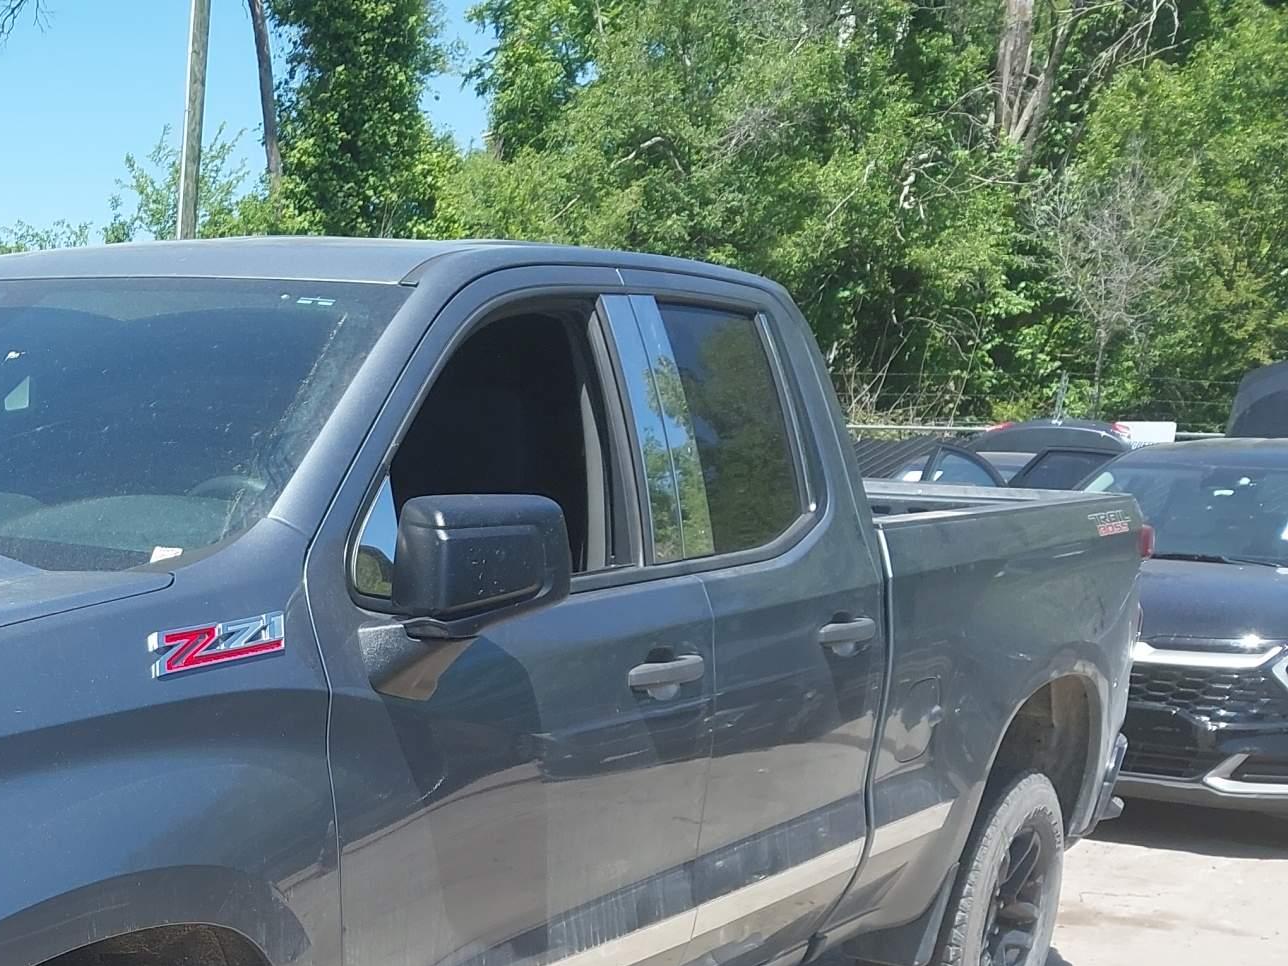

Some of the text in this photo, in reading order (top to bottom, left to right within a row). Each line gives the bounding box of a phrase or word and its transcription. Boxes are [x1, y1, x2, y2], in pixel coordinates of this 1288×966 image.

[1087, 509, 1132, 525] TRAIL
[1096, 521, 1130, 537] BOSS
[147, 610, 286, 679] Z71
